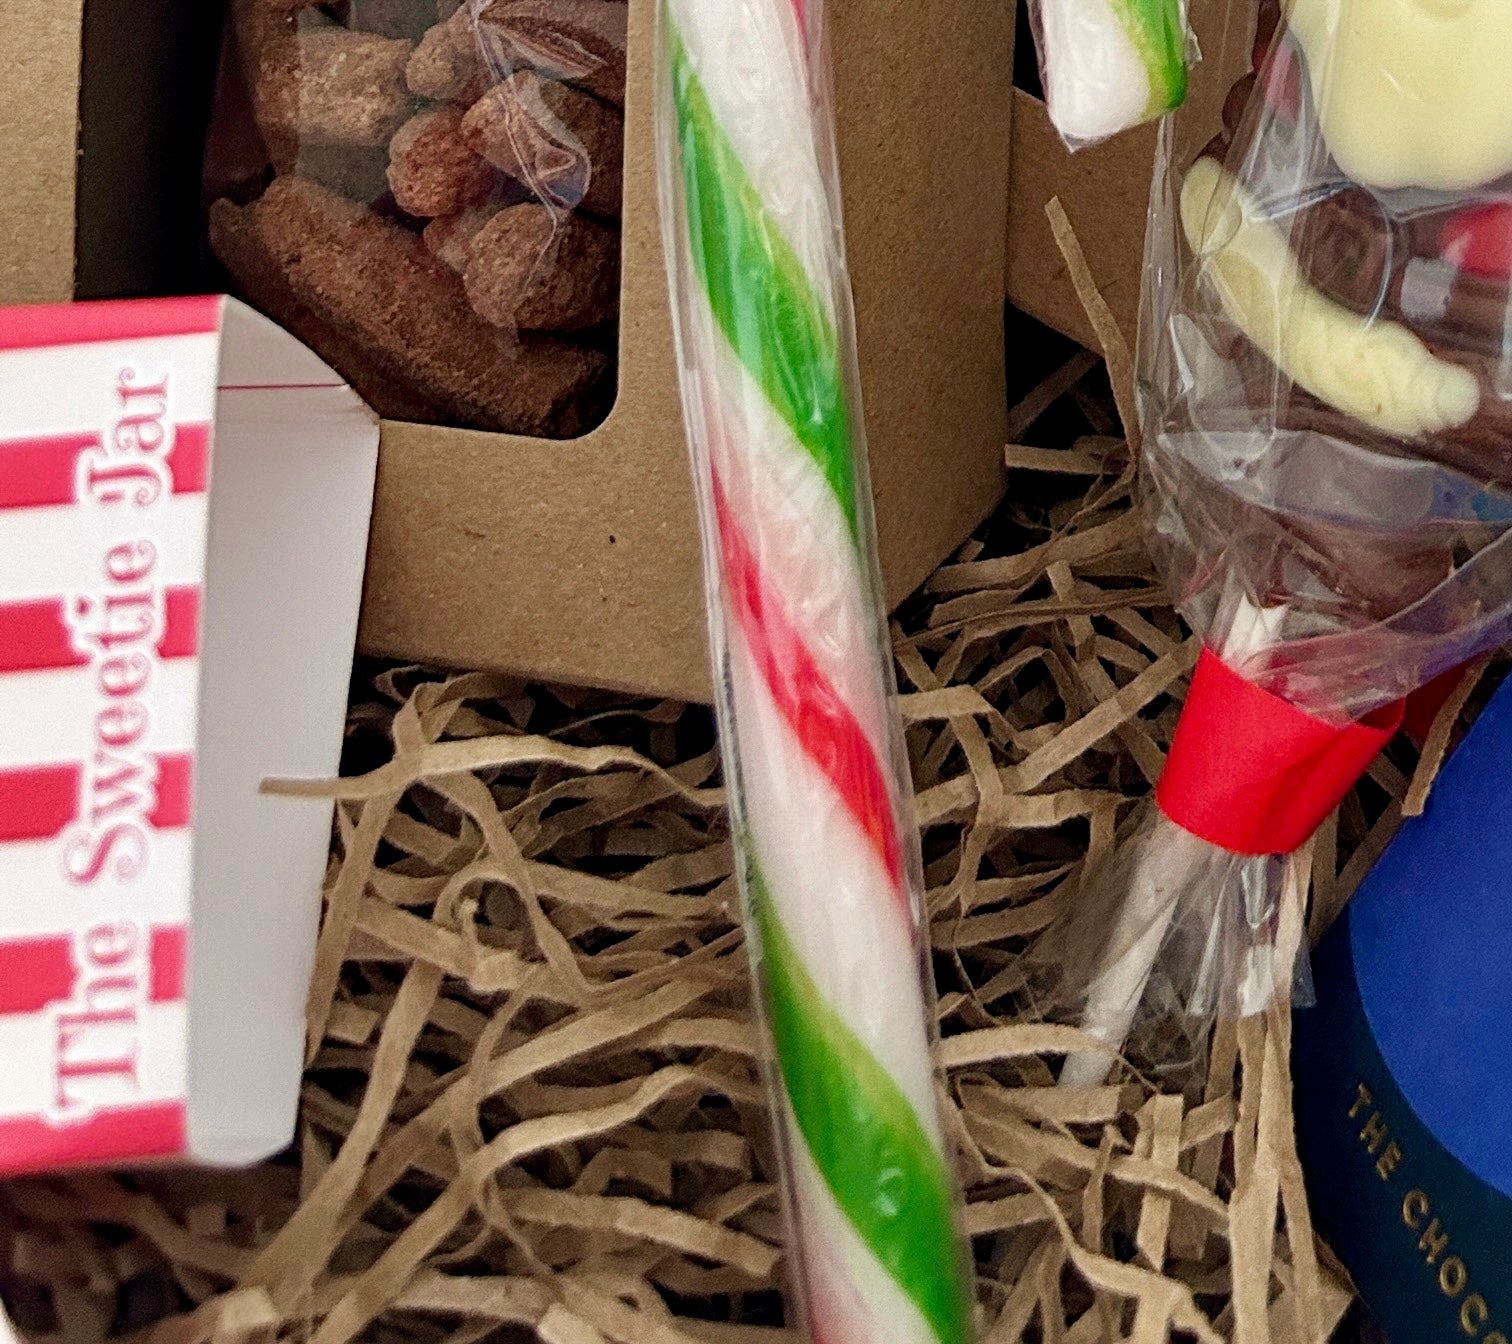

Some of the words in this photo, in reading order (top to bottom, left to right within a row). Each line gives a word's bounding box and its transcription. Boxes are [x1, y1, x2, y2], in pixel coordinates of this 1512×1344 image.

[90, 367, 170, 506] Jar
[63, 538, 157, 887] Sweetie
[57, 920, 139, 1109] The
[1349, 1083, 1401, 1181] THE
